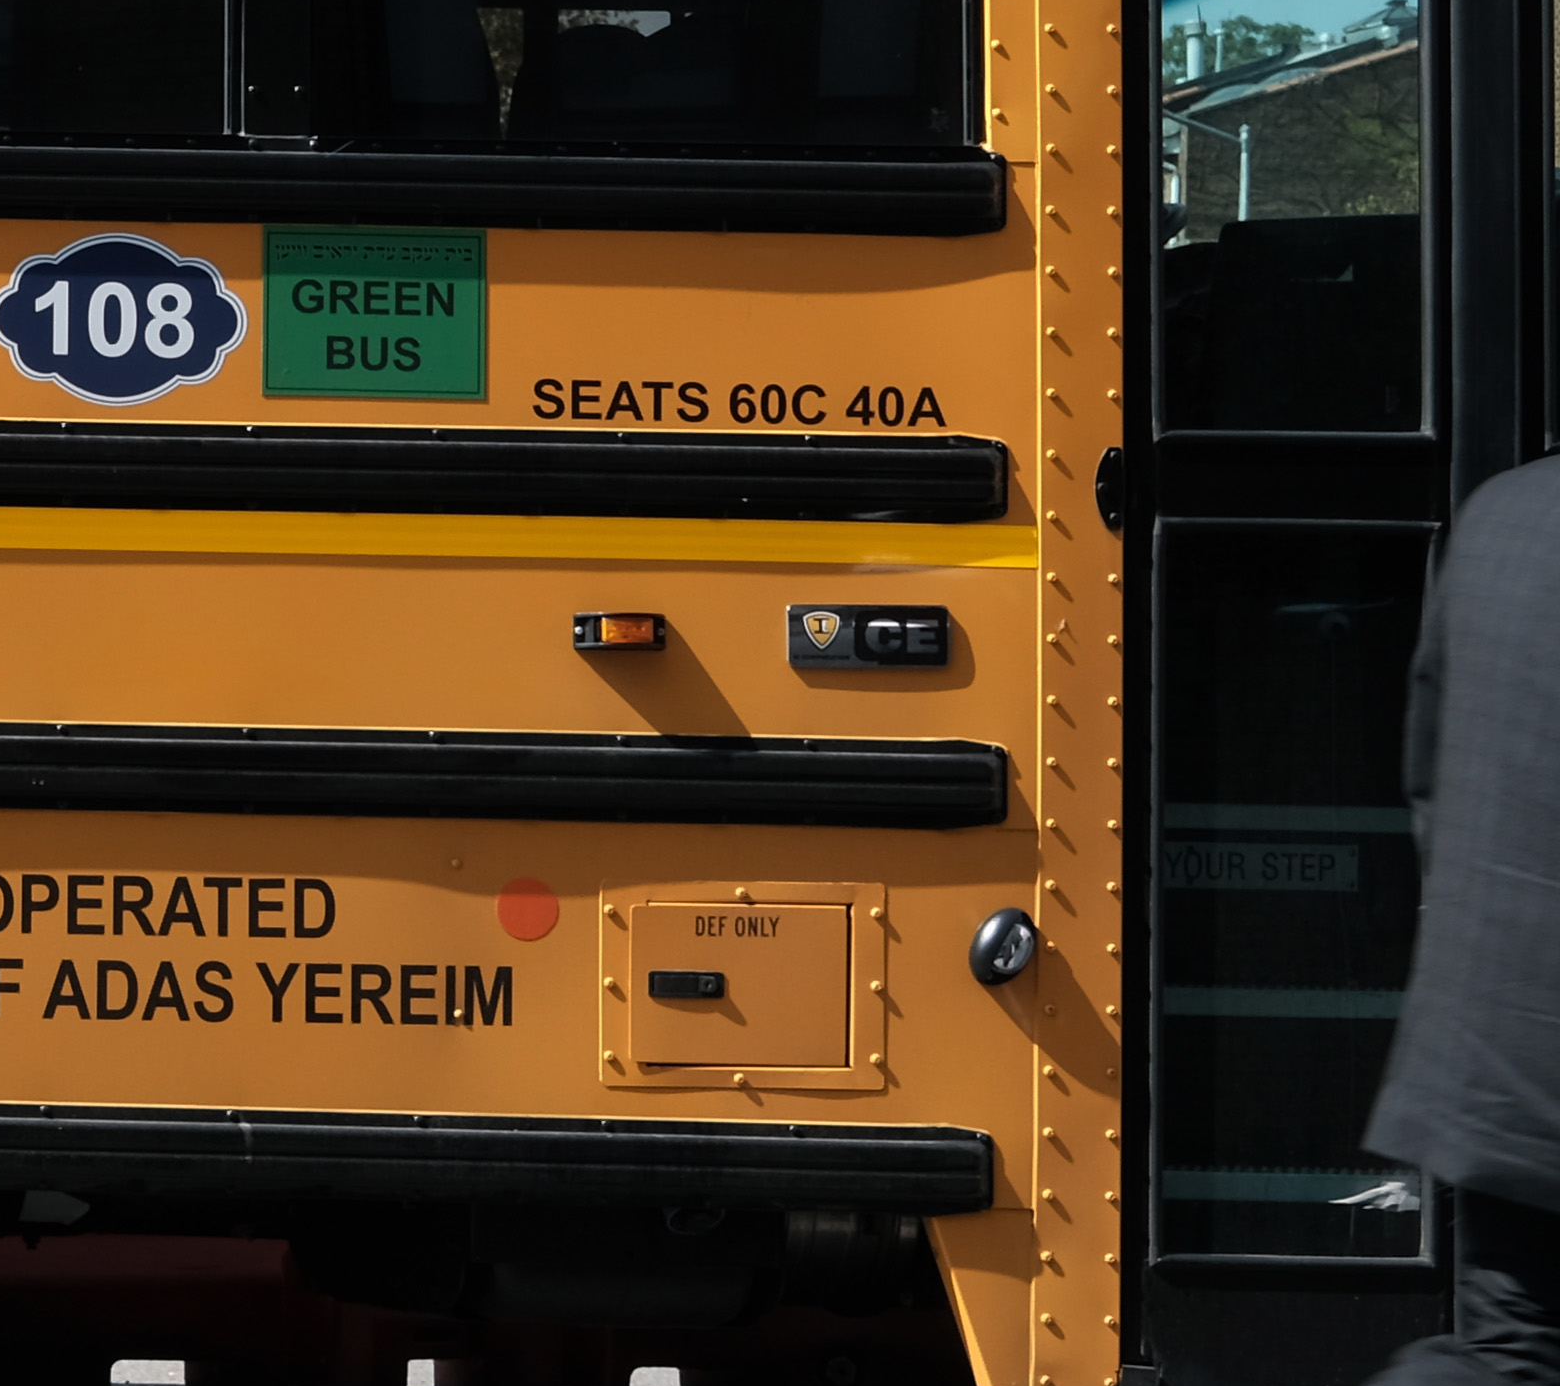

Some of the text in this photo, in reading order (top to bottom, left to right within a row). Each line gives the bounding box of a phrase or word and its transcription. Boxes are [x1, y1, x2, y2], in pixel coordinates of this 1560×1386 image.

[444, 247, 473, 261] בית
[291, 278, 456, 318] GREEN
[34, 280, 195, 359] 108
[325, 335, 422, 372] BUS
[532, 378, 947, 428] SEATS 60C 40A
[864, 618, 940, 654] CE
[1165, 850, 1336, 882] YOUR STEP
[695, 915, 780, 937] DEF ONLY
[42, 959, 234, 1023] ADAS
[255, 962, 515, 1030] YEREIM
